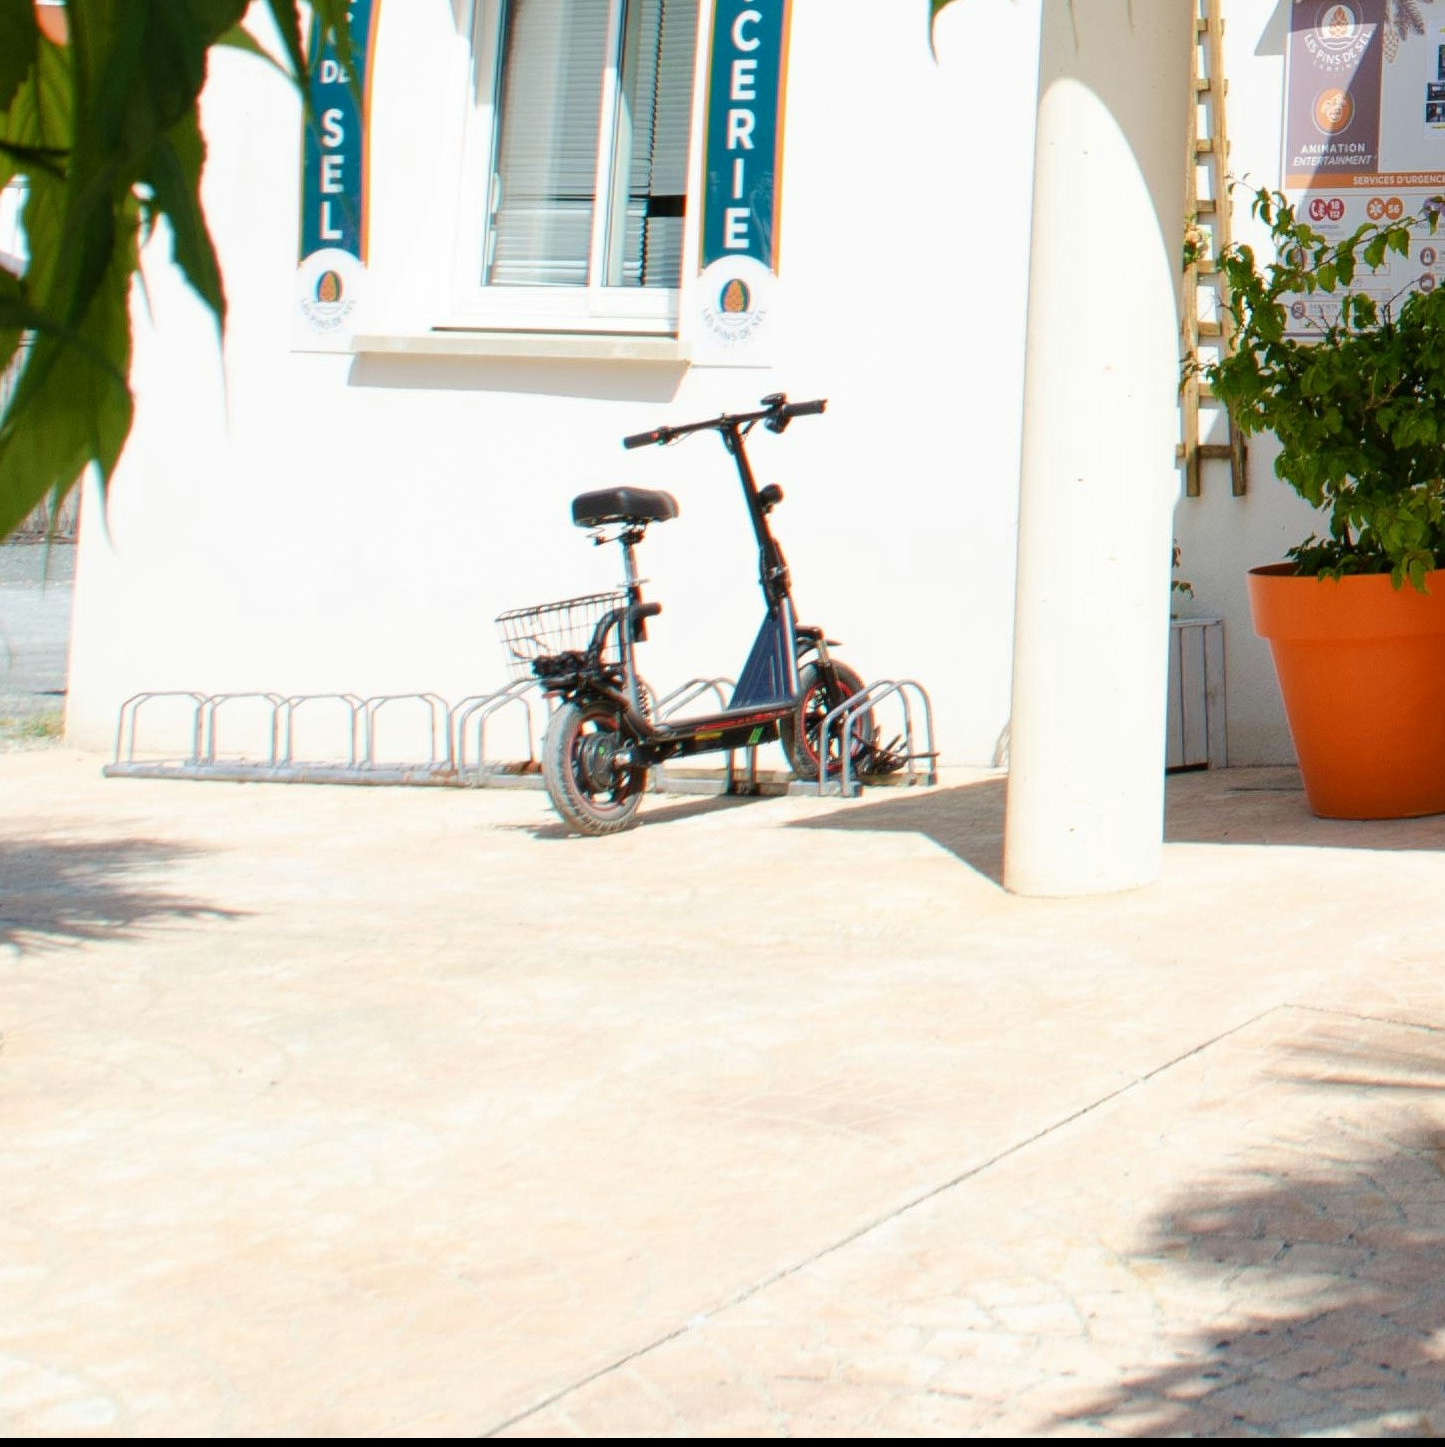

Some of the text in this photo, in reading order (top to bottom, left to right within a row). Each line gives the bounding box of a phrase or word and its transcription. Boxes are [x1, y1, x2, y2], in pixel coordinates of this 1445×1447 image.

[1304, 34, 1319, 54] LES
[1301, 143, 1365, 154] ANIMATION
[1293, 155, 1372, 167] ENTERTAINMENT
[320, 108, 344, 240] SEL
[1353, 176, 1394, 185] SERVICES
